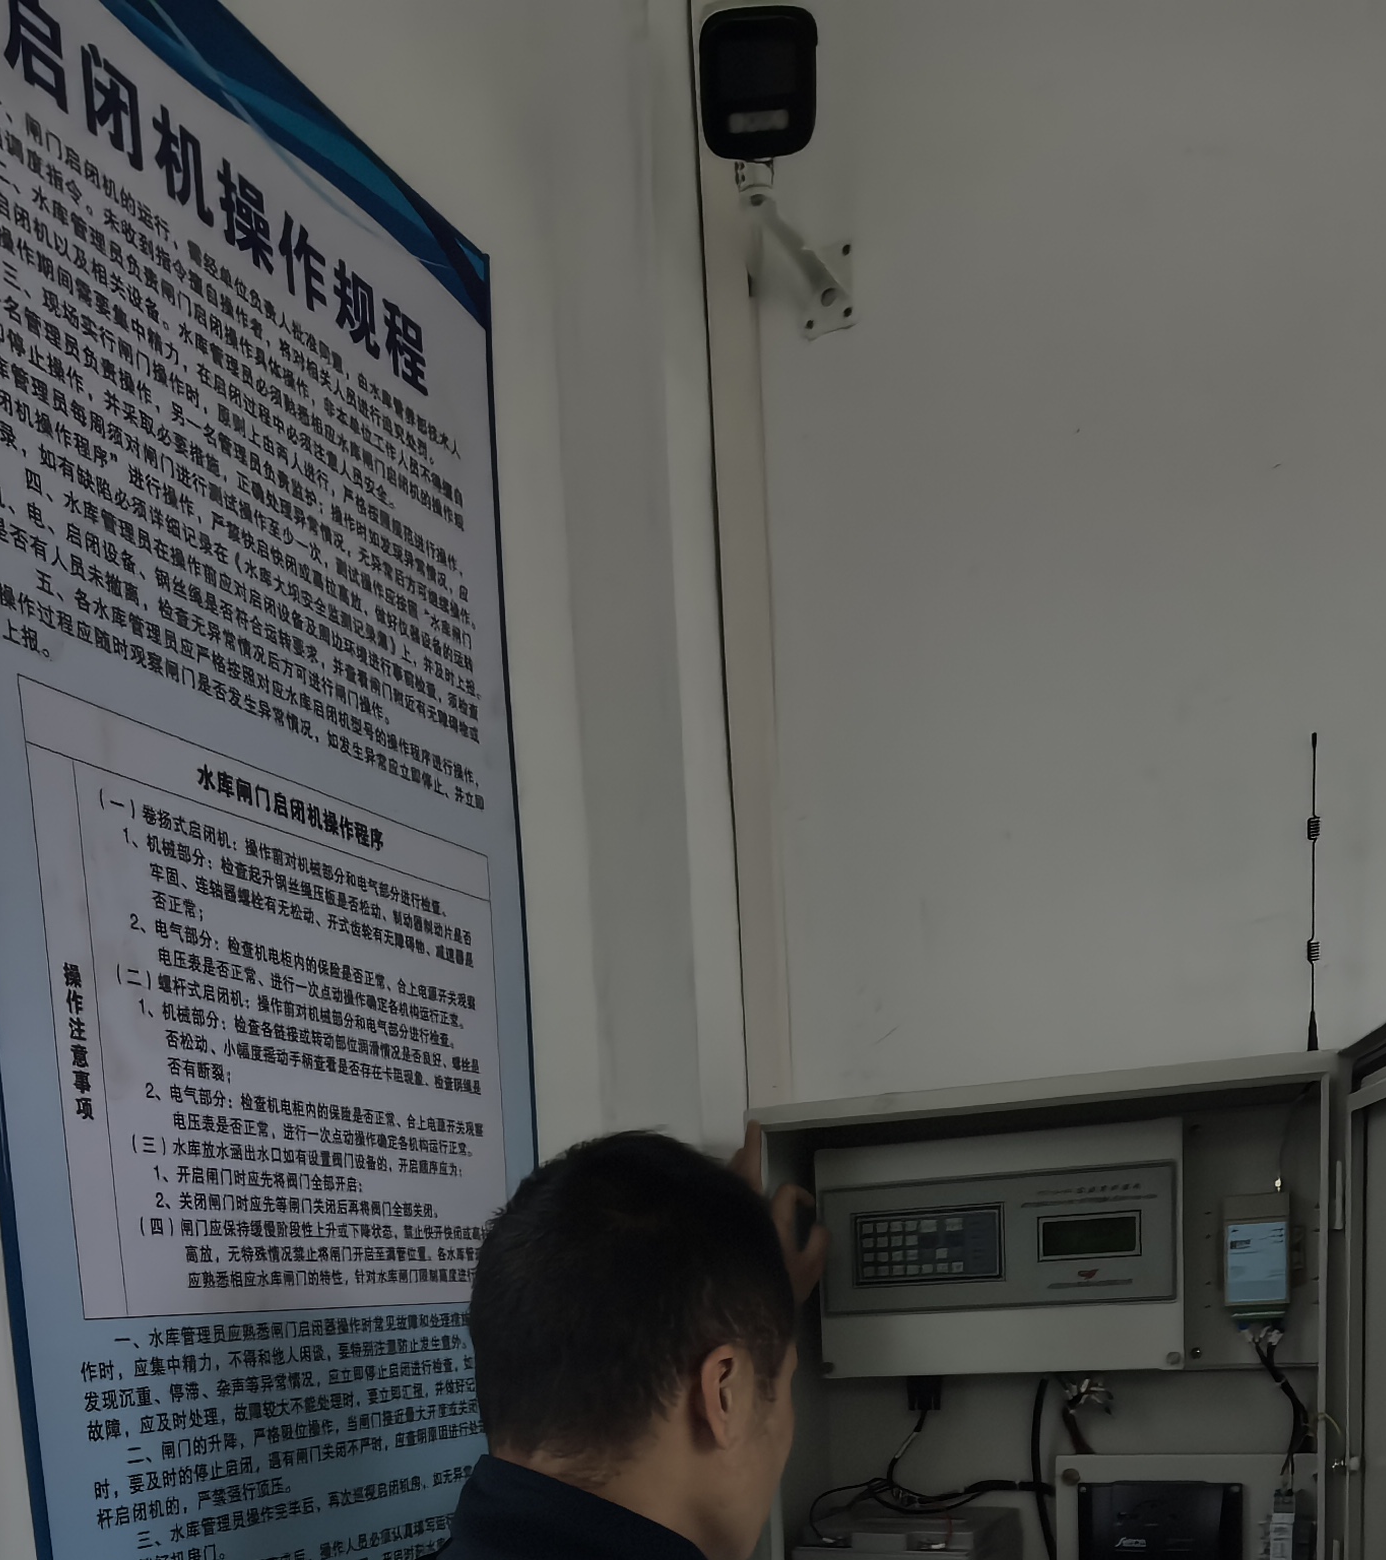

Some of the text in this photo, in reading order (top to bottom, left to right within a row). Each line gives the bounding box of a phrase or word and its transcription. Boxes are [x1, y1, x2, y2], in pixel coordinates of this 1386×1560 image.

[3, 0, 428, 396] 启闭机操作规程
[2, 618, 49, 657] 上报。
[196, 763, 383, 851] 水库闸门启闭机操作程序
[62, 961, 94, 1120] 操作注意事项
